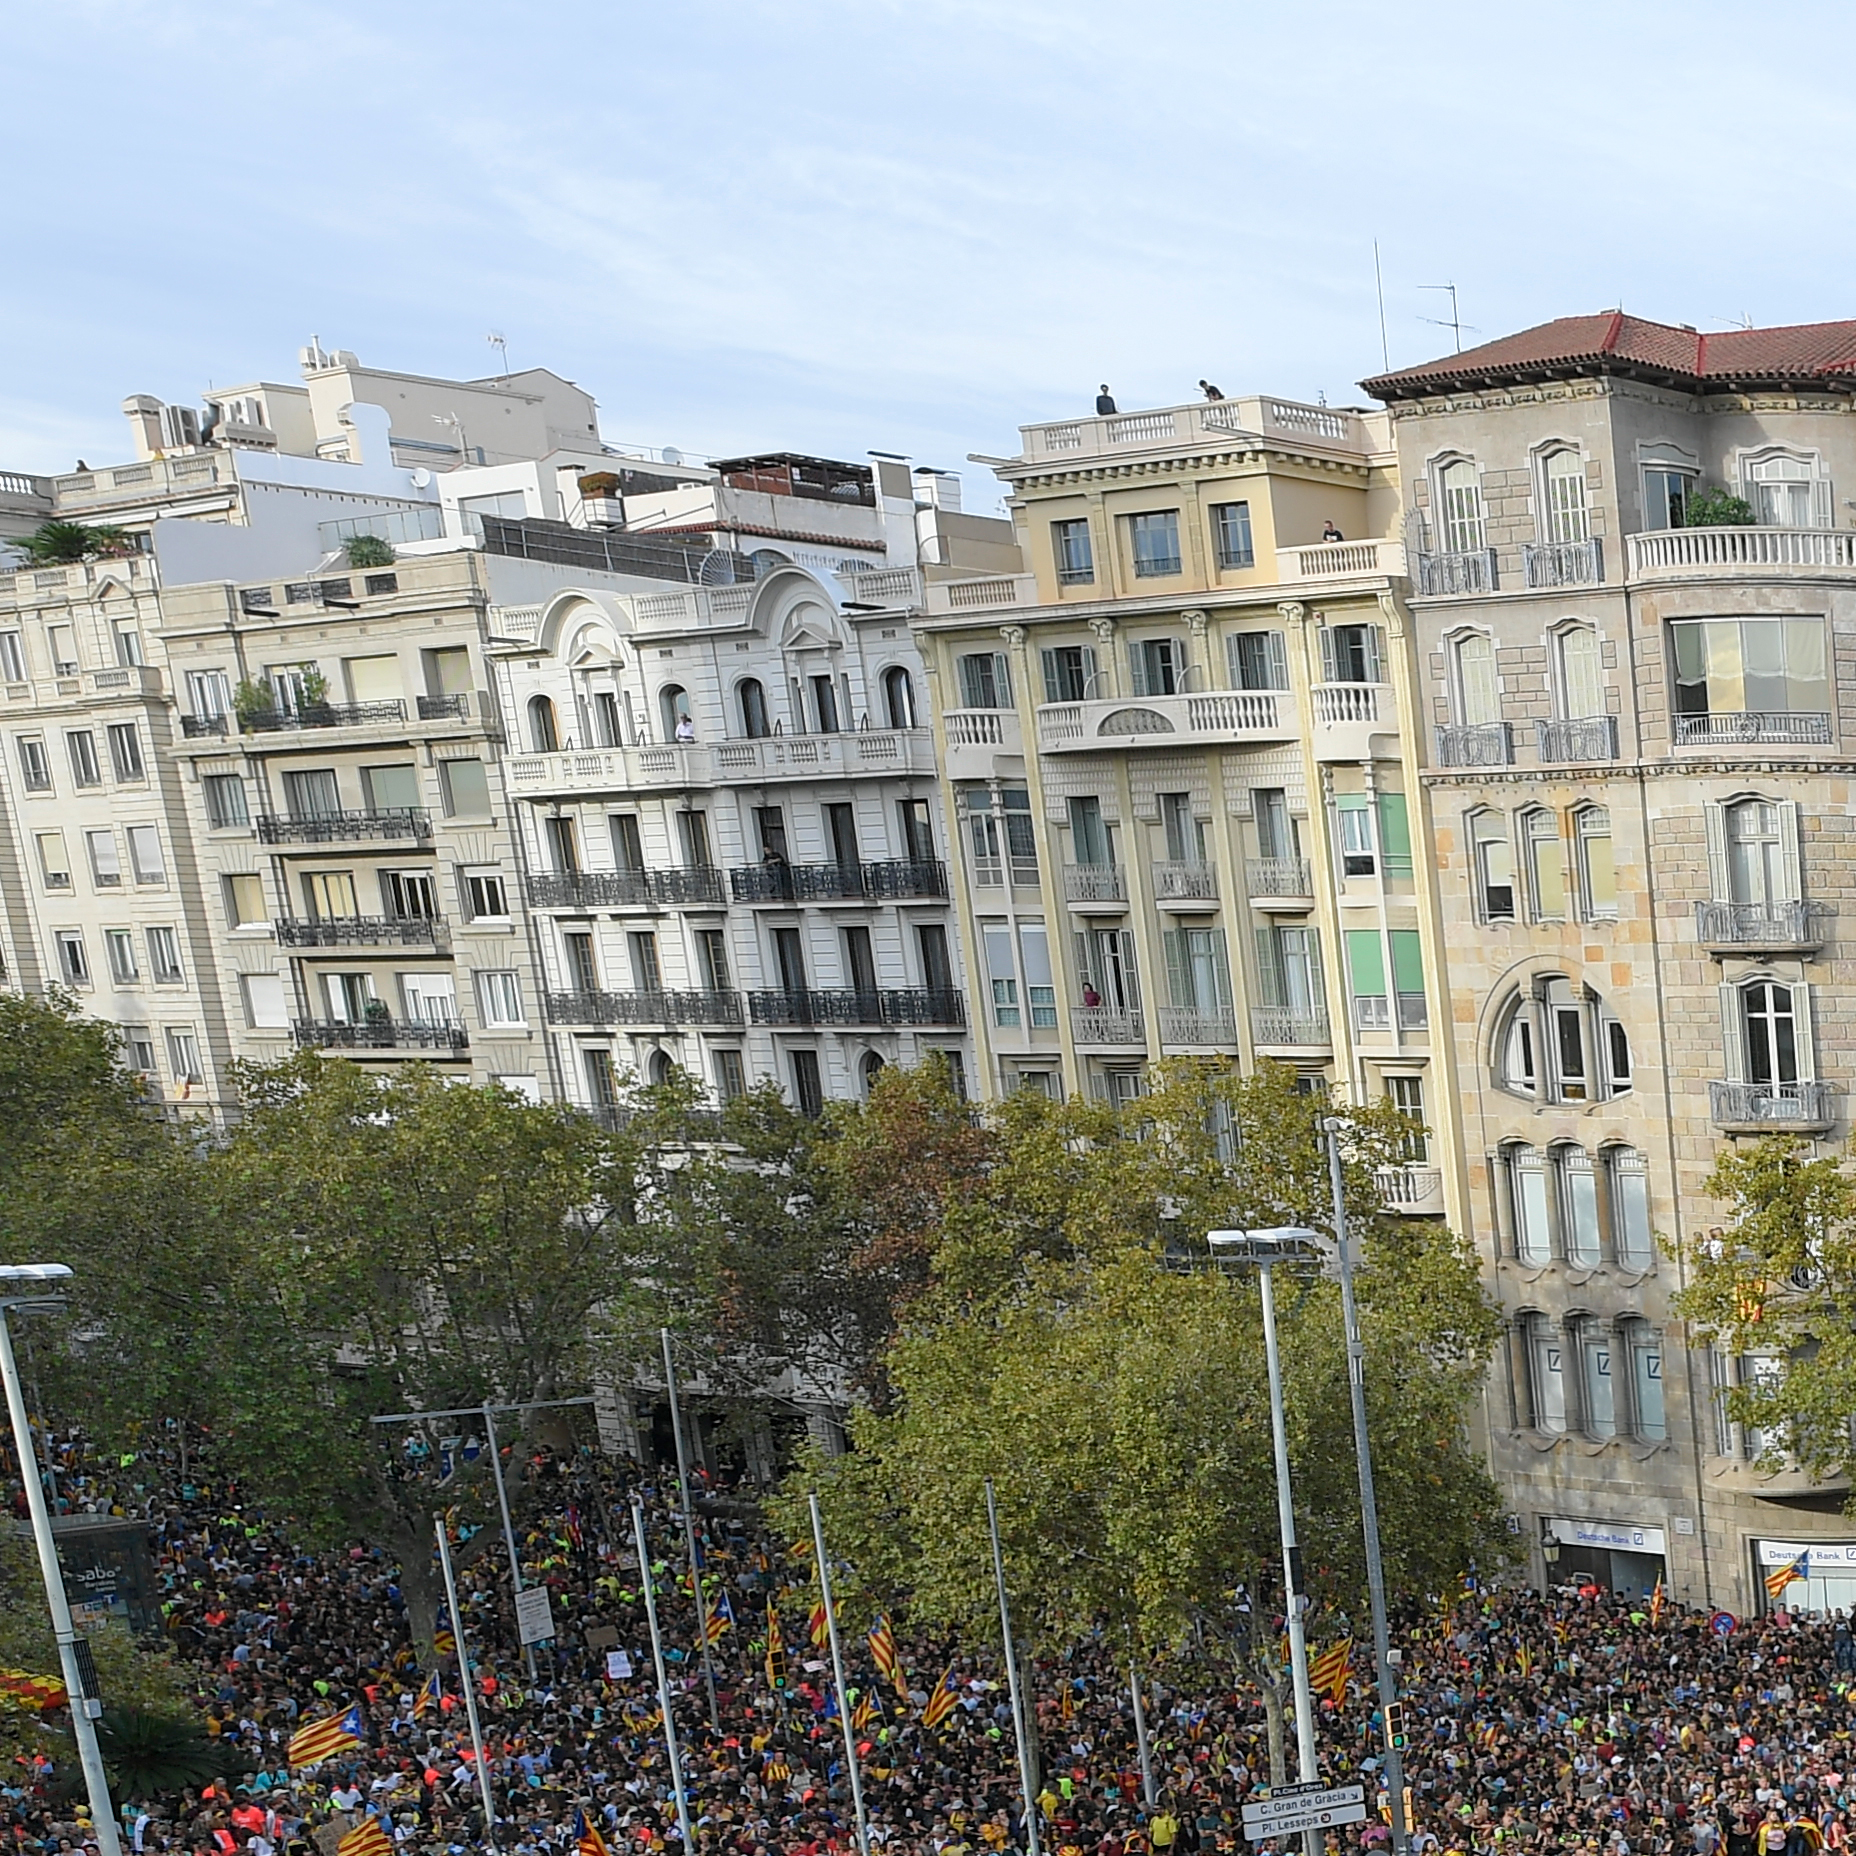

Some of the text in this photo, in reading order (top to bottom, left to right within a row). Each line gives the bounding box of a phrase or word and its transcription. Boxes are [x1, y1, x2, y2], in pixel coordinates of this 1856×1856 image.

[1769, 1550, 1841, 1560] Deutse Bank
[1260, 1792, 1347, 1815] C. Gran de Gràcia
[1262, 1816, 1319, 1833] Pl. Lesseps
